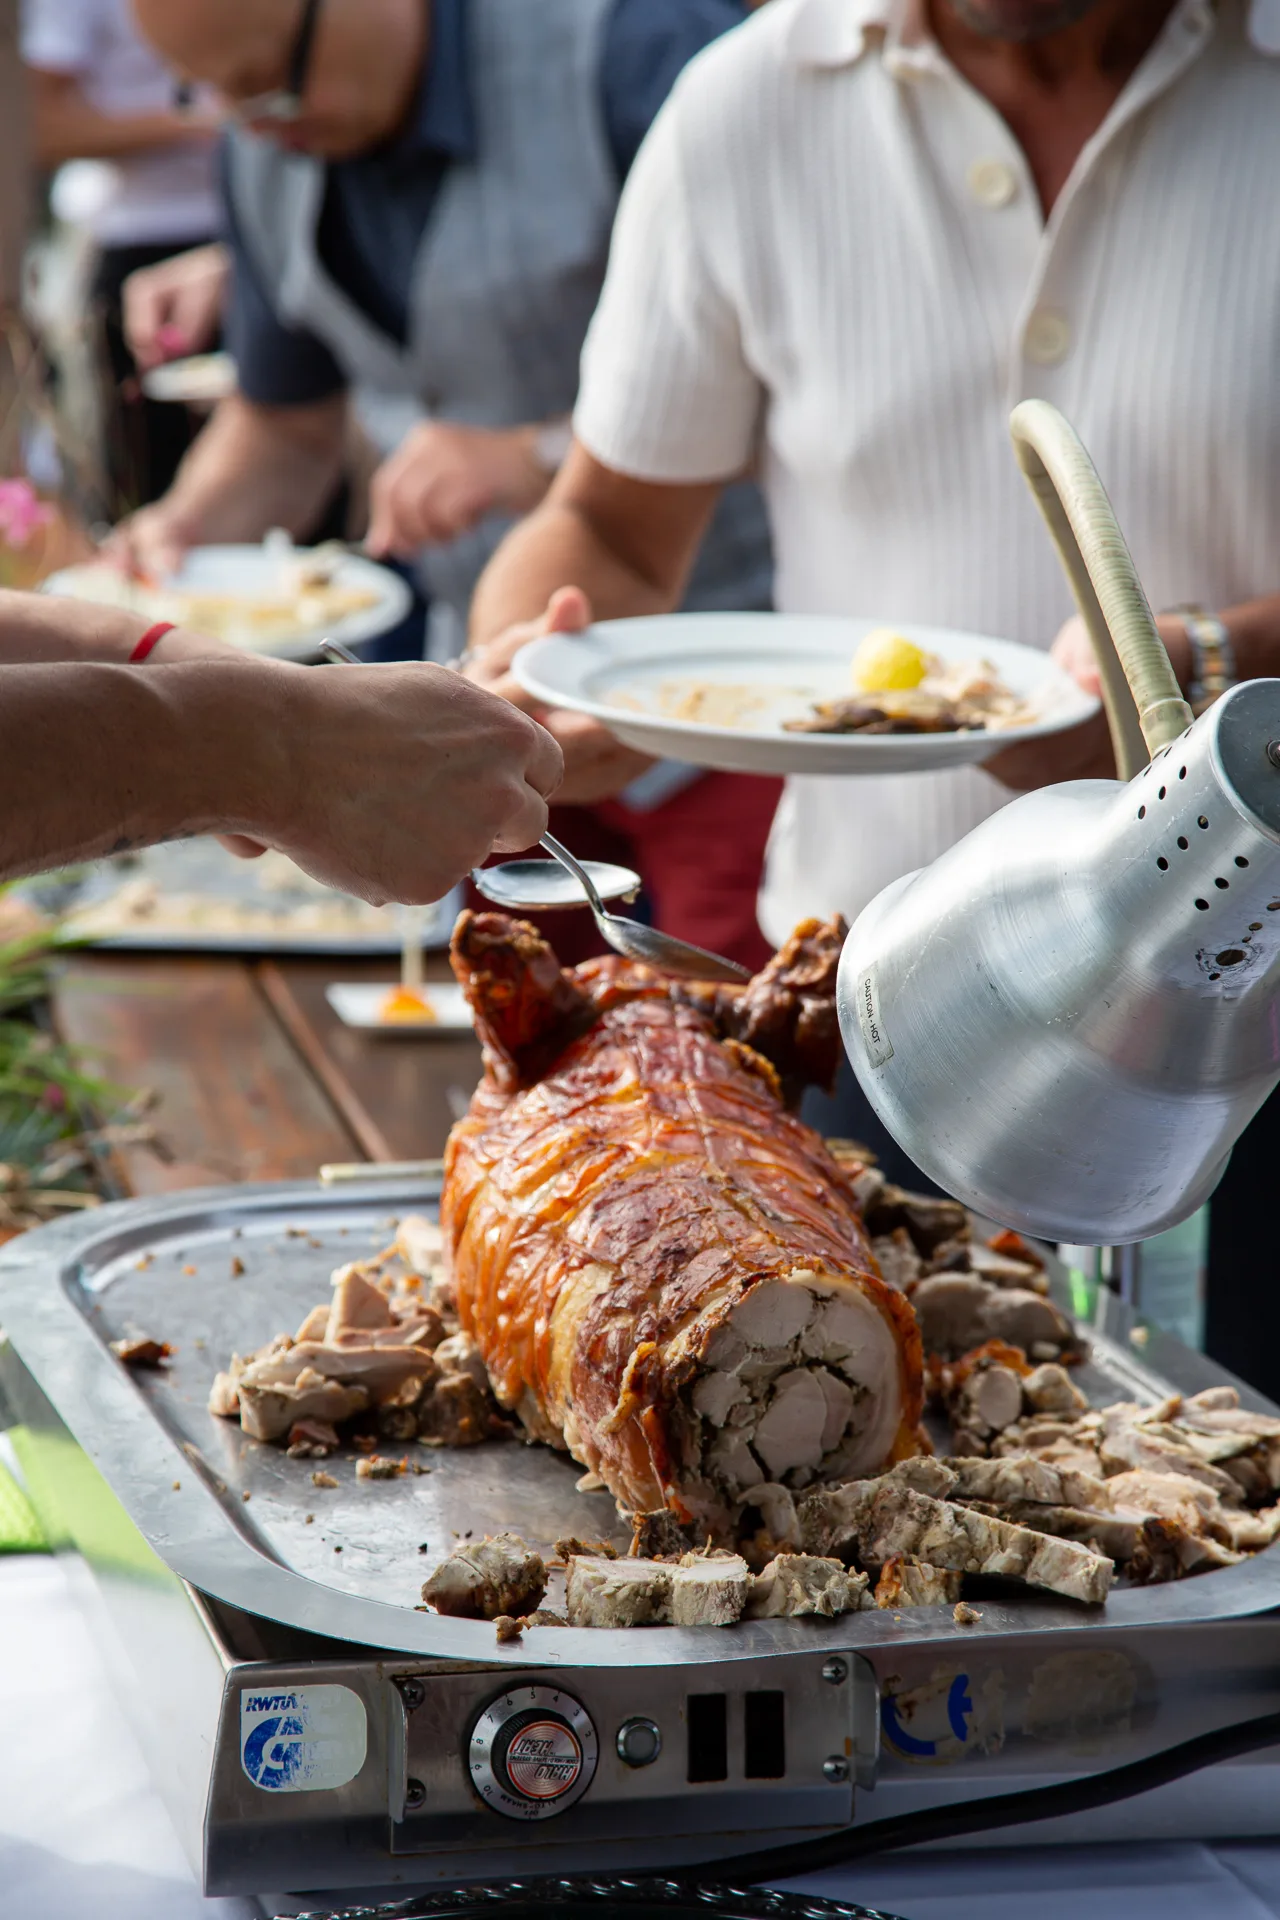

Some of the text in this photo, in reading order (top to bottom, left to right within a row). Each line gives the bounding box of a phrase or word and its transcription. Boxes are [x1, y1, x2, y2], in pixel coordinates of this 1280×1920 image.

[864, 978, 874, 1018] CAUTION
[870, 1023, 881, 1044] HOT
[530, 1691, 536, 1699] 5
[552, 1695, 559, 1703] 4
[506, 1698, 513, 1706] 6
[573, 1709, 580, 1717] 3
[487, 1714, 494, 1723] 7
[585, 1730, 592, 1738] 2
[515, 1739, 554, 1754] HEAT
[535, 1765, 574, 1780] HALO
[483, 1785, 493, 1796] 10
